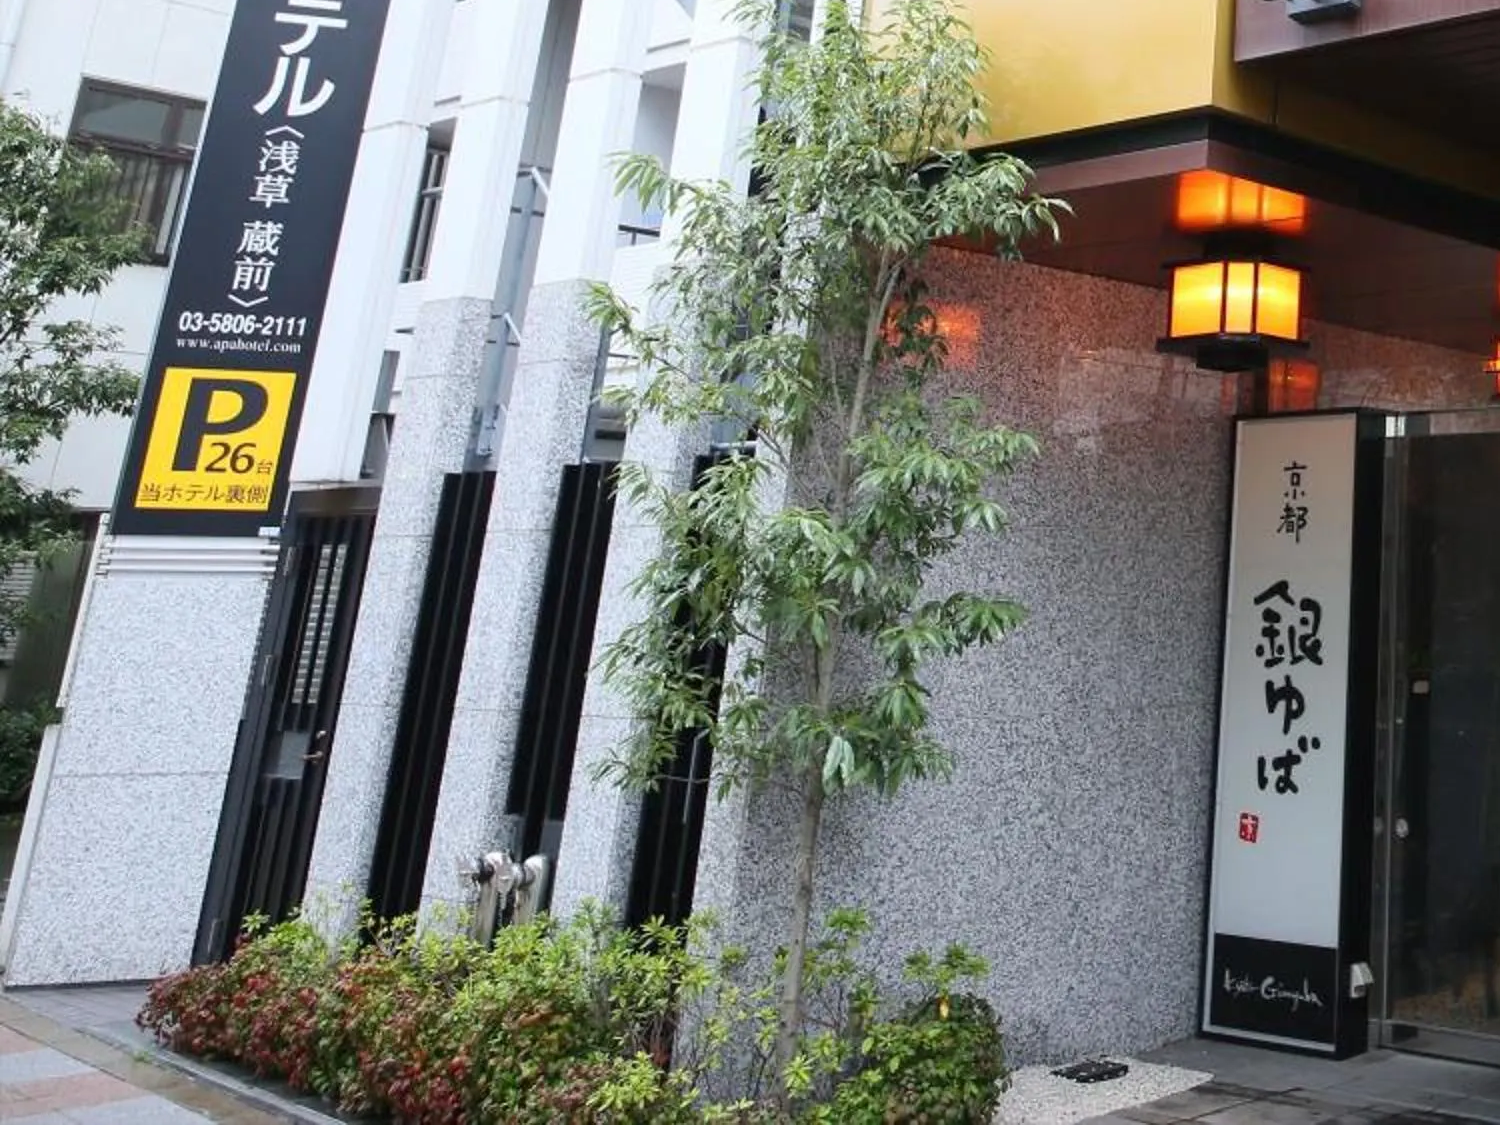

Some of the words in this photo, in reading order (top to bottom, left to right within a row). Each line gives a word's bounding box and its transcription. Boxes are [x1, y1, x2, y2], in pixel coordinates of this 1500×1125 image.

[176, 337, 302, 353] www.apahotel.com
[179, 311, 307, 336] 03-5806-2111
[171, 377, 270, 472] P
[139, 483, 270, 505] 当ホテル裏側
[1277, 460, 1309, 544] 京都
[1253, 579, 1324, 795] 銀ゆば
